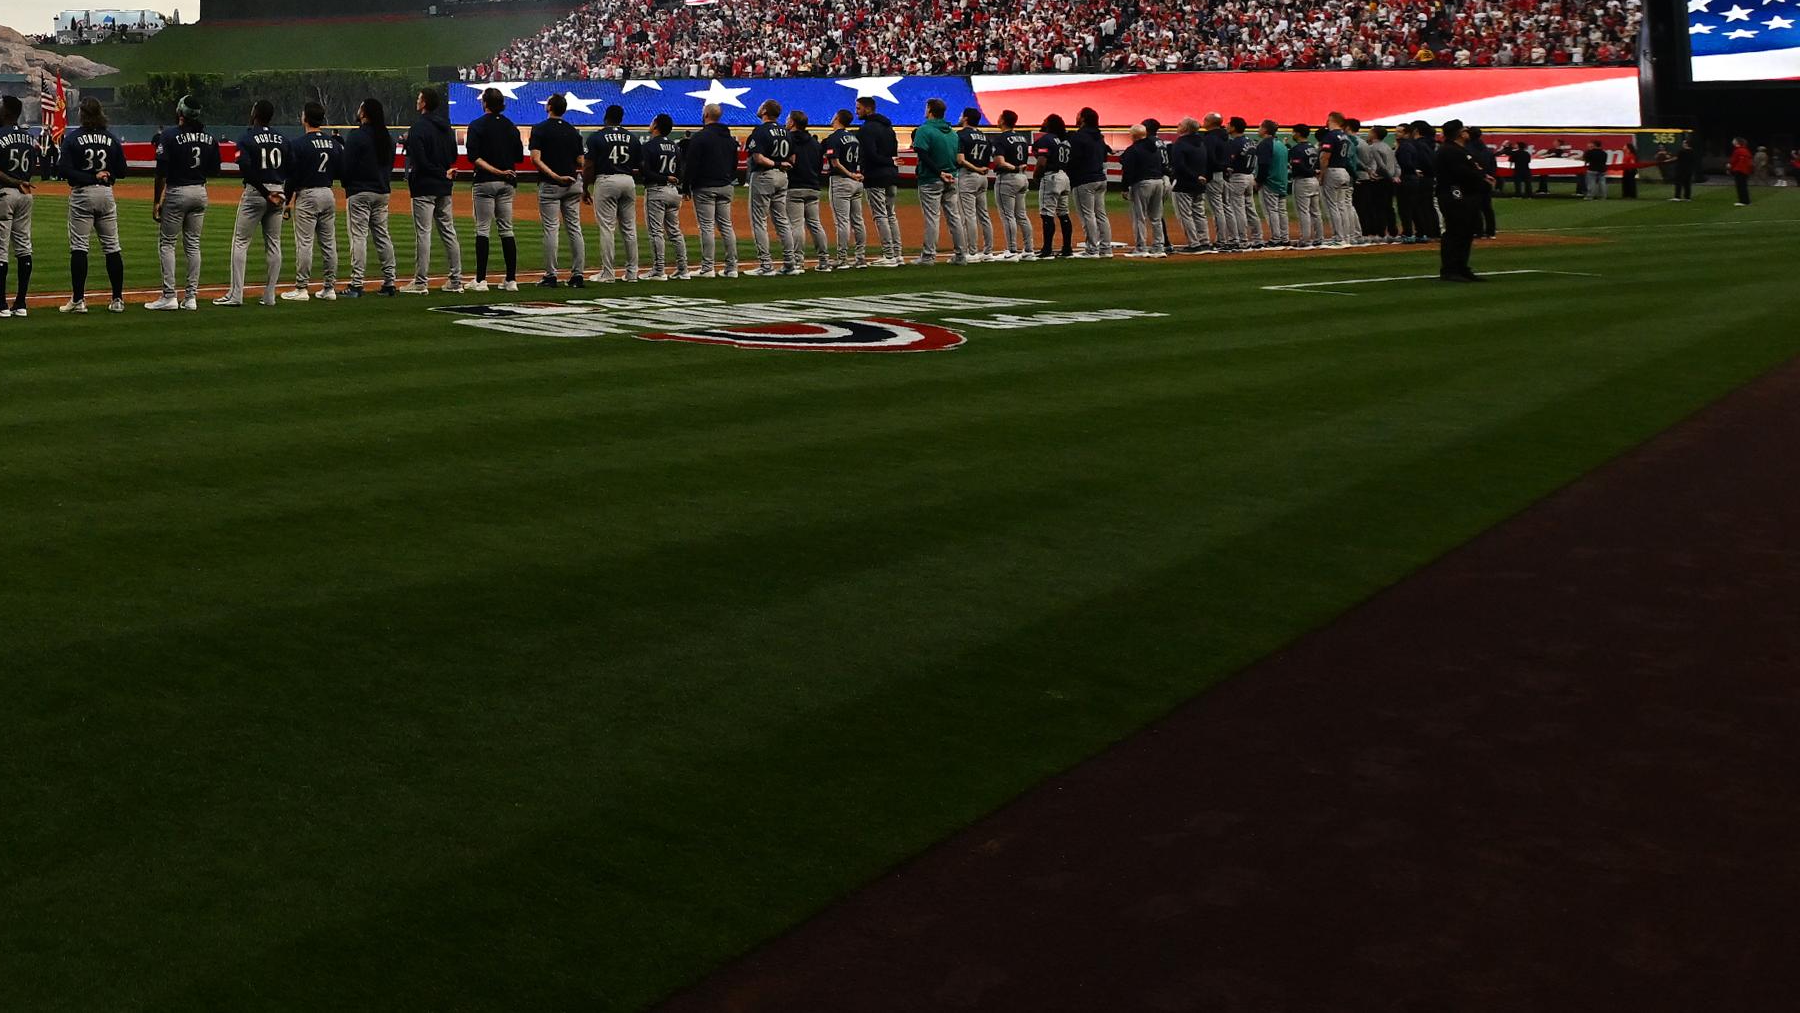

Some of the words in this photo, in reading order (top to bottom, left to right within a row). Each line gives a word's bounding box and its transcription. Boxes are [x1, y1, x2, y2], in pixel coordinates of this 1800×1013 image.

[77, 134, 112, 147] DONOVAN
[253, 133, 283, 145] ROBLES
[604, 133, 631, 144] FERRER
[190, 146, 201, 169] 3
[608, 145, 630, 165] 45
[771, 139, 790, 158] 20
[845, 145, 860, 163] 64
[970, 143, 986, 161] 47
[1016, 144, 1024, 162] 8
[1058, 146, 1071, 164] 83
[8, 149, 29, 173] 56
[82, 148, 107, 172] 33
[261, 147, 282, 170] 10
[317, 152, 329, 173] 2
[659, 154, 677, 174] 76
[453, 302, 877, 338] OPENING
